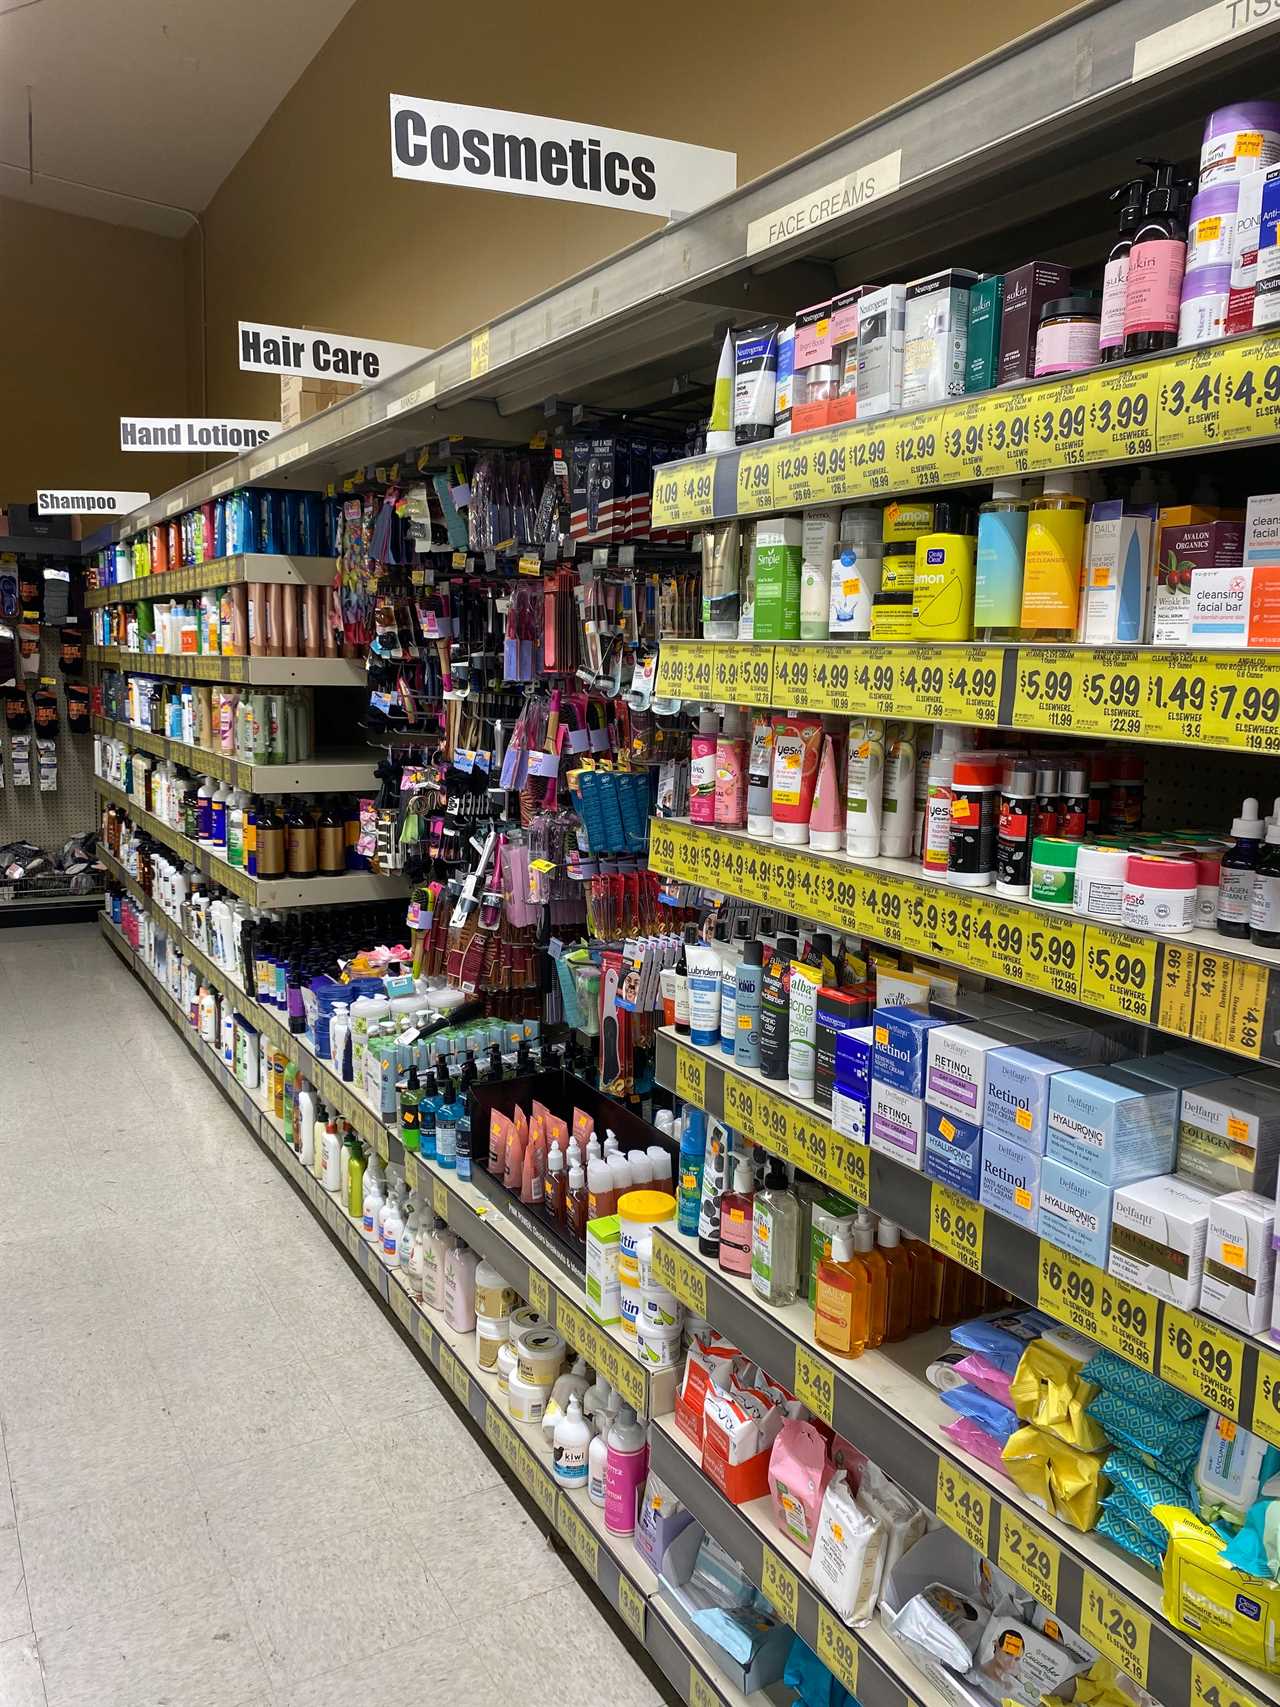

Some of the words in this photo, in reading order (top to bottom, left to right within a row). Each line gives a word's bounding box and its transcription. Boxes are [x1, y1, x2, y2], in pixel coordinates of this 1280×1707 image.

[394, 109, 656, 201] Cosmetics
[769, 212, 804, 243] FACE
[809, 177, 875, 227] CREAMS
[914, 280, 940, 295] Neutrogena
[1006, 280, 1027, 301] sukin
[802, 311, 825, 323] Neutrogena
[859, 297, 888, 314] Neutrogena
[242, 330, 305, 368] Hair
[312, 340, 380, 378] Care
[1034, 405, 1086, 443] $3.99
[1090, 393, 1148, 433] $3.99
[122, 424, 181, 447] Hand
[188, 424, 270, 448] Lotions
[895, 434, 935, 462] $12.99
[1125, 439, 1151, 455] $8.99
[813, 447, 845, 476] $9.99
[850, 439, 885, 467] $12.99
[740, 464, 769, 490] $7.99
[777, 455, 808, 480] $12.99
[656, 482, 677, 504] $1.09
[684, 476, 711, 500] $4.99
[38, 493, 116, 513] Shampoo
[1175, 541, 1209, 550] ORGANICS
[1184, 532, 1209, 540] AVALON
[1253, 528, 1278, 538] facial
[759, 555, 780, 567] Simple
[1197, 591, 1244, 601] cleansing
[1197, 603, 1222, 612] facial
[1226, 603, 1241, 611] bar
[660, 661, 683, 682] $9.99
[684, 661, 710, 684] $3.49
[740, 661, 768, 685] $5.99
[776, 661, 808, 686] $4.99
[813, 663, 849, 689] $4.99
[854, 665, 894, 691] $4.99
[900, 666, 943, 693] $4.99
[948, 668, 996, 697] $4.99
[1020, 670, 1072, 701] $5.99
[1083, 673, 1140, 706] $5.99
[1147, 676, 1205, 711] $1.49
[876, 701, 893, 713] $7.99
[925, 704, 943, 716] $7.99
[976, 708, 995, 720] $9.99
[1210, 685, 1280, 722] $7.99
[1048, 713, 1072, 727] $11.99
[1110, 718, 1141, 733] $22.99
[653, 837, 674, 859] $2.99
[821, 877, 856, 907] $3.99
[862, 887, 900, 920] $4.99
[884, 925, 901, 941] $8.99
[973, 917, 1022, 954] $4.99
[1027, 932, 1076, 969] $5.99
[1002, 963, 1023, 978] $9.99
[1088, 946, 1146, 989] $5.99
[1166, 950, 1181, 988] $4.99
[1200, 958, 1216, 997] $4.99
[739, 982, 755, 993] KIND
[791, 979, 812, 995] alba
[1051, 977, 1077, 994] $12.99
[1119, 997, 1146, 1016] $12.99
[818, 1013, 846, 1028] Neutrogena
[1241, 1007, 1260, 1048] $4.99
[876, 1043, 910, 1063] Retinol
[935, 1054, 972, 1076] RETINOL
[680, 1059, 700, 1086] $1.99
[726, 1084, 753, 1117] $5.99
[989, 1083, 1030, 1111] Retinol
[758, 1104, 787, 1137] $3.99
[878, 1102, 913, 1125] RETINOL
[1184, 1100, 1220, 1122] Delfanti
[1053, 1111, 1103, 1143] HYALURONIC
[1181, 1125, 1230, 1151] COLLAGEN
[793, 1120, 826, 1161] $4.99
[929, 1138, 971, 1163] HYALURONIC
[831, 1143, 865, 1180] $7.99
[984, 1160, 1027, 1190] Retinol
[1044, 1195, 1096, 1226] HYALURONIC
[1116, 1201, 1152, 1226] Delfanti
[935, 1204, 977, 1248] $6.99
[1043, 1258, 1094, 1307] $6.99
[1070, 1310, 1097, 1334] $29.99
[1119, 1339, 1149, 1364] $29.99
[1168, 1322, 1232, 1382] $6.99
[621, 1367, 644, 1398] $4.99
[797, 1360, 832, 1400] $3.49
[1201, 1383, 1234, 1411] $29.99
[564, 1453, 585, 1461] kiwi
[939, 1472, 984, 1527] $3.49
[1182, 1518, 1203, 1532] lemon
[1004, 1524, 1051, 1580] $2.29
[1032, 1582, 1052, 1606] $2.99
[1088, 1589, 1137, 1650] $1.29
[822, 1624, 854, 1668] $3.99
[1025, 1652, 1060, 1676] Cucumber
[1121, 1653, 1142, 1680] $2.19
